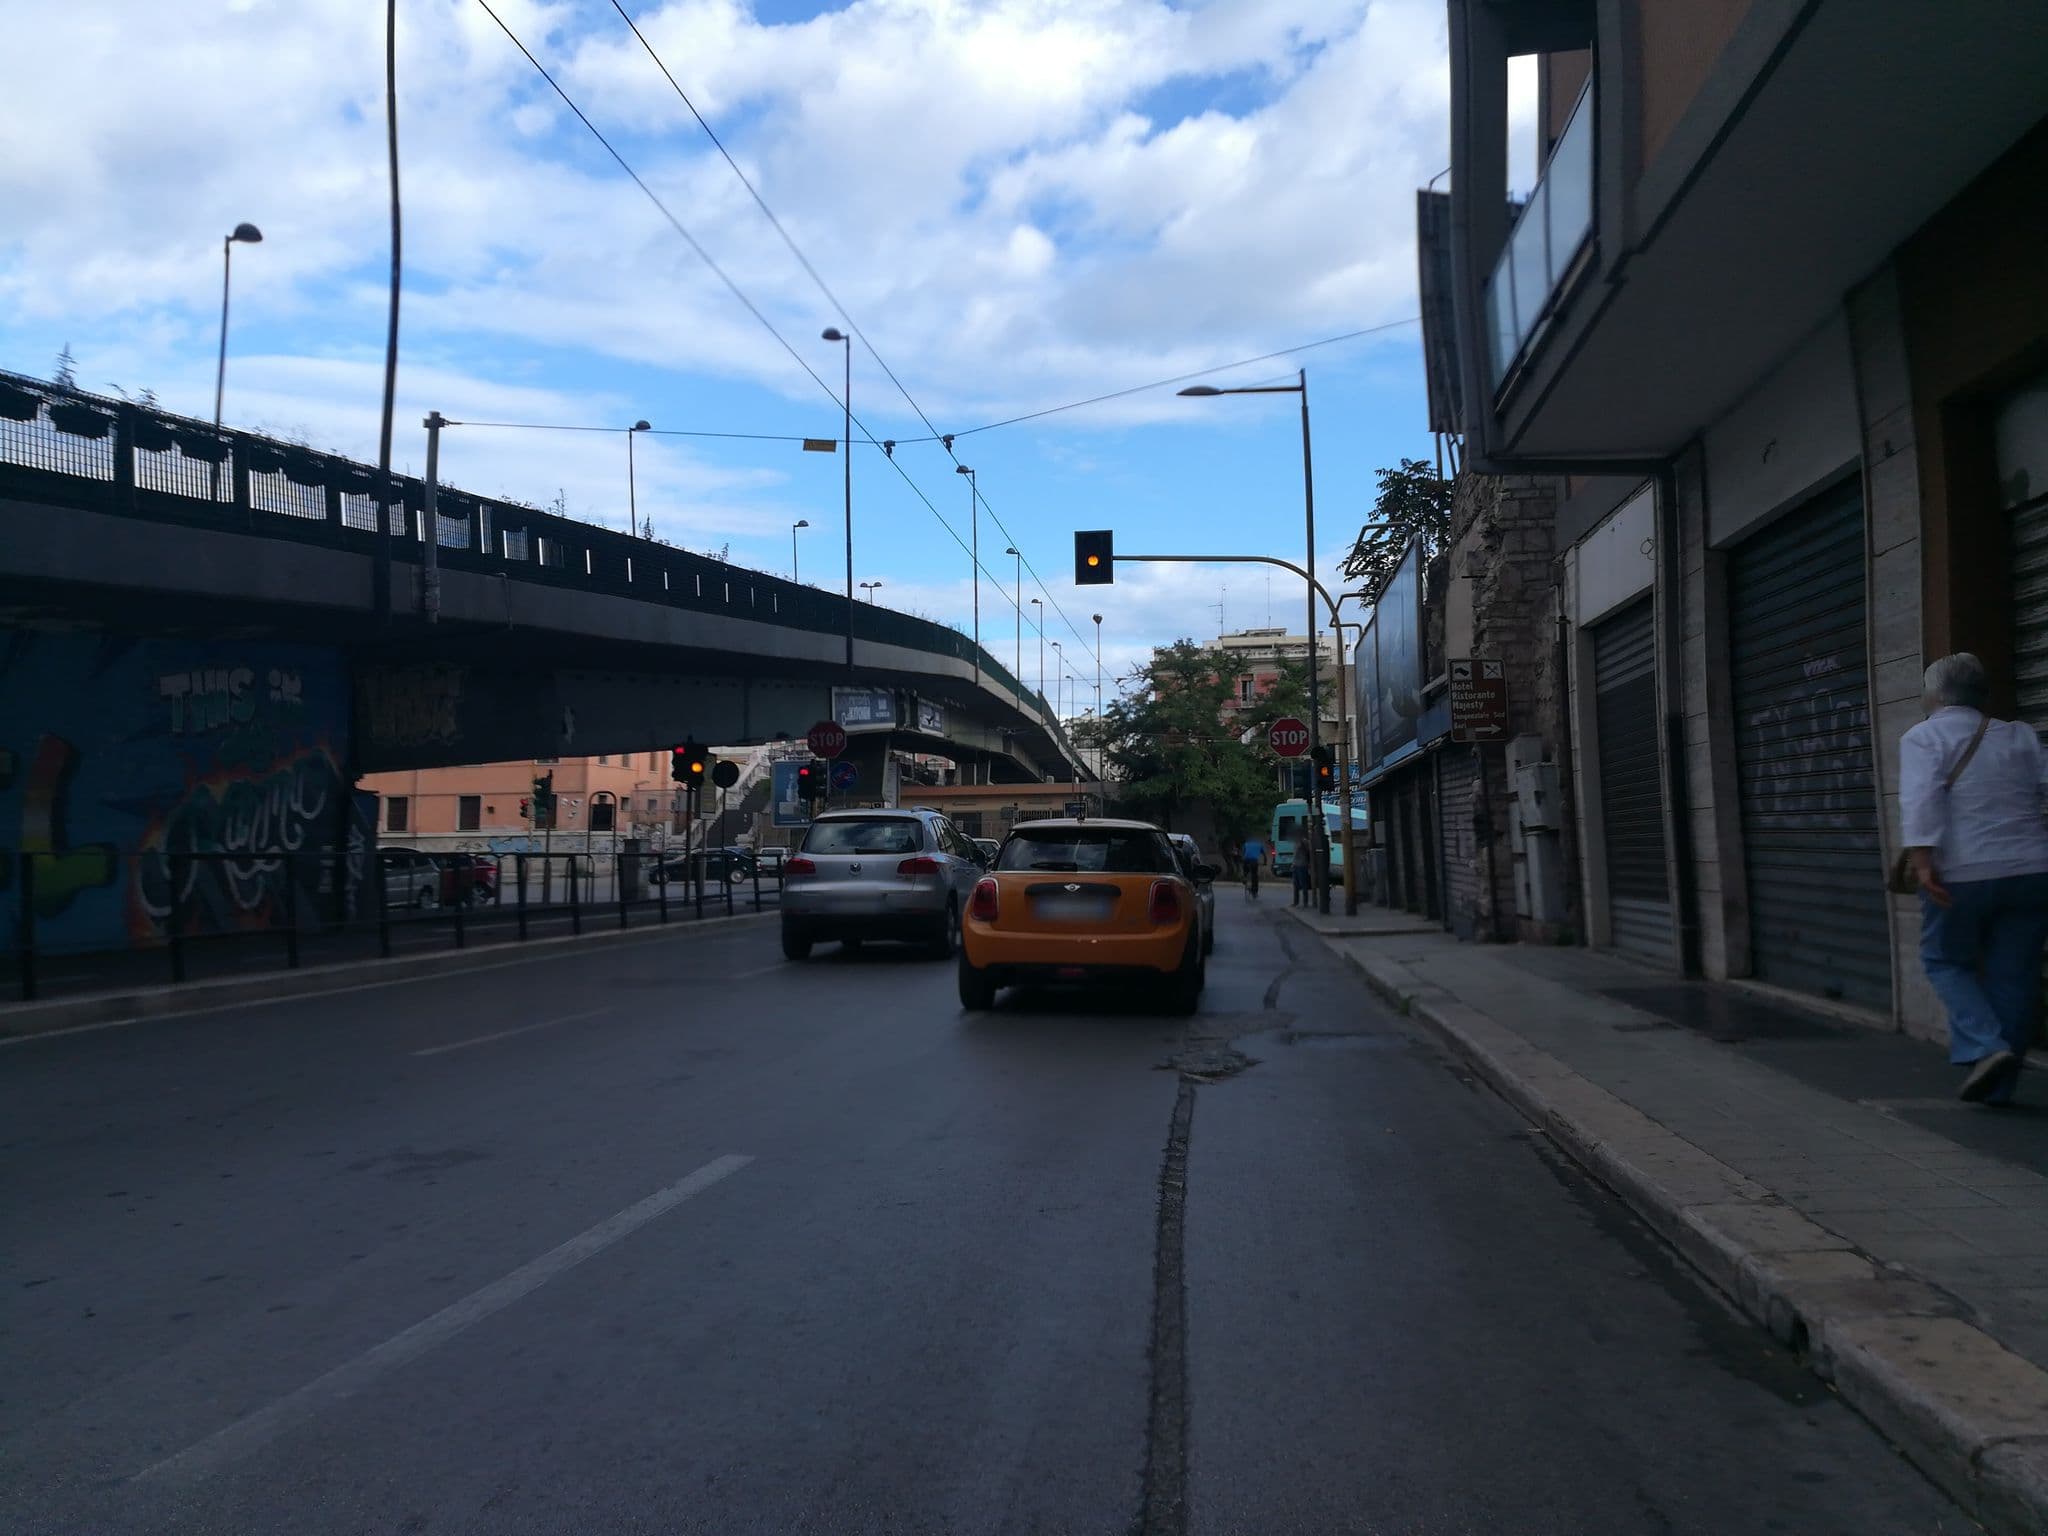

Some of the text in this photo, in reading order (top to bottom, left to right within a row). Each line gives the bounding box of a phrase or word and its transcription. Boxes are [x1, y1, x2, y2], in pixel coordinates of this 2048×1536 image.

[1451, 682, 1473, 691] Hotel
[1452, 691, 1496, 700] Ristorante
[1452, 701, 1484, 711] Majesty
[810, 731, 844, 748] STOP
[1272, 730, 1308, 746] STOP
